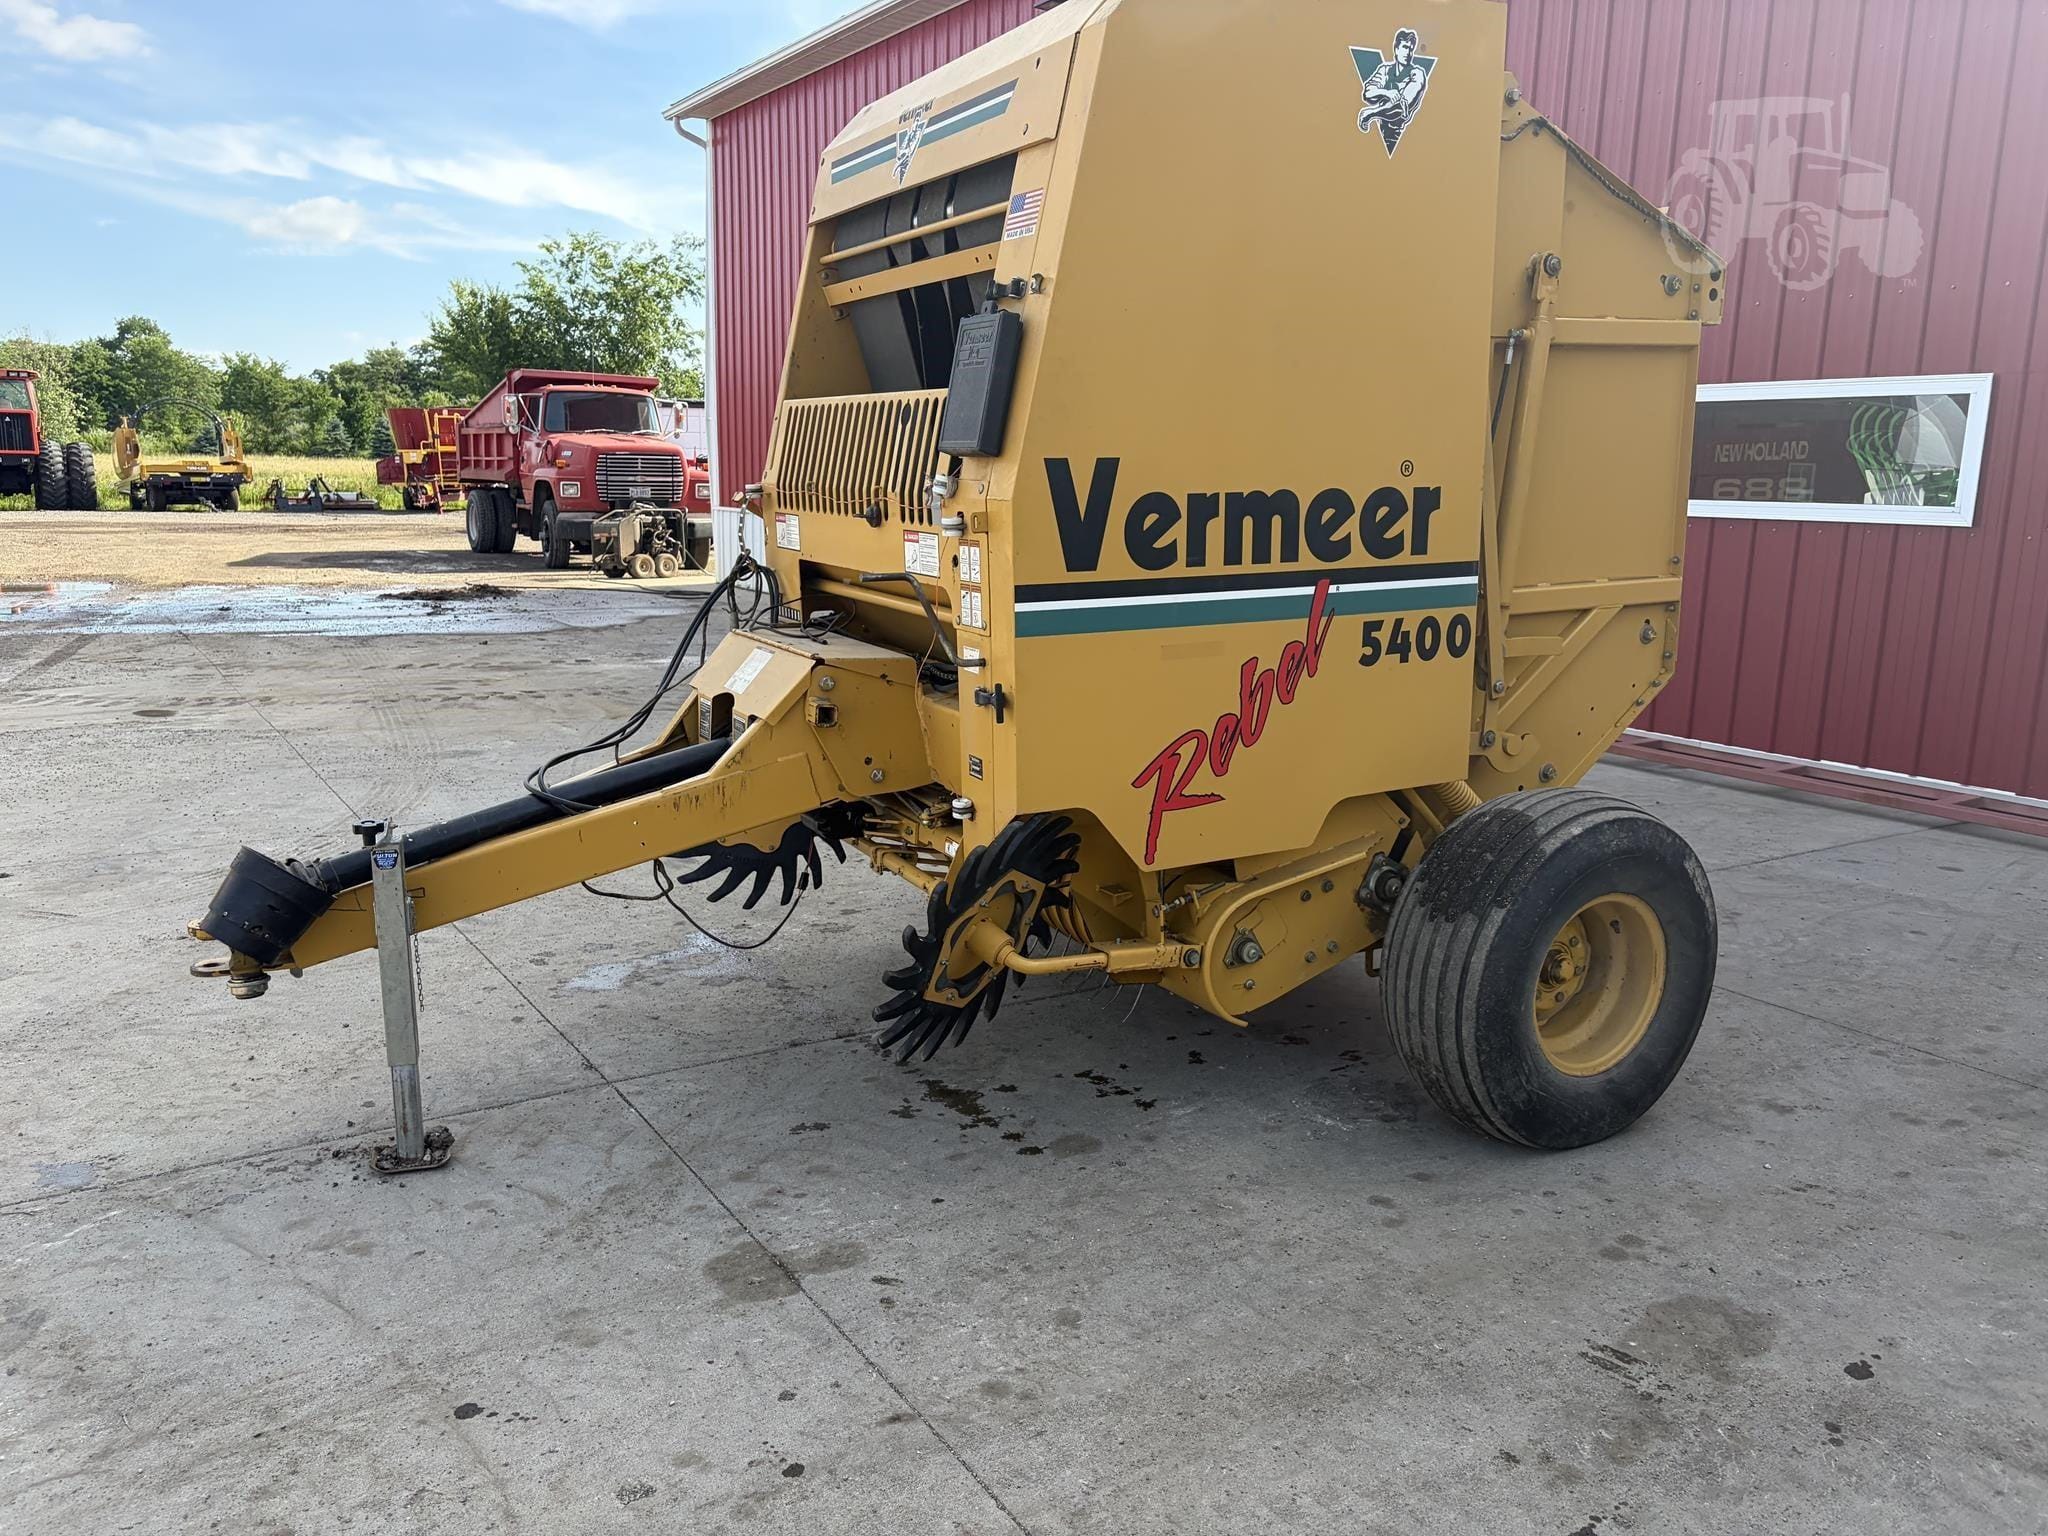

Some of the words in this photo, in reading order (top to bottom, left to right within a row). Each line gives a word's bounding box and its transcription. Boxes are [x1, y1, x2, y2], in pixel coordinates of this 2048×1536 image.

[1006, 230, 1018, 238] MADE
[1019, 228, 1024, 236] IN
[1025, 226, 1034, 234] USA
[1714, 442, 1744, 462] NEW
[1744, 440, 1809, 461] HOLLAND
[1043, 457, 1442, 572] Vermeer
[1358, 613, 1472, 667] 5400
[1131, 578, 1335, 866] Rebel
